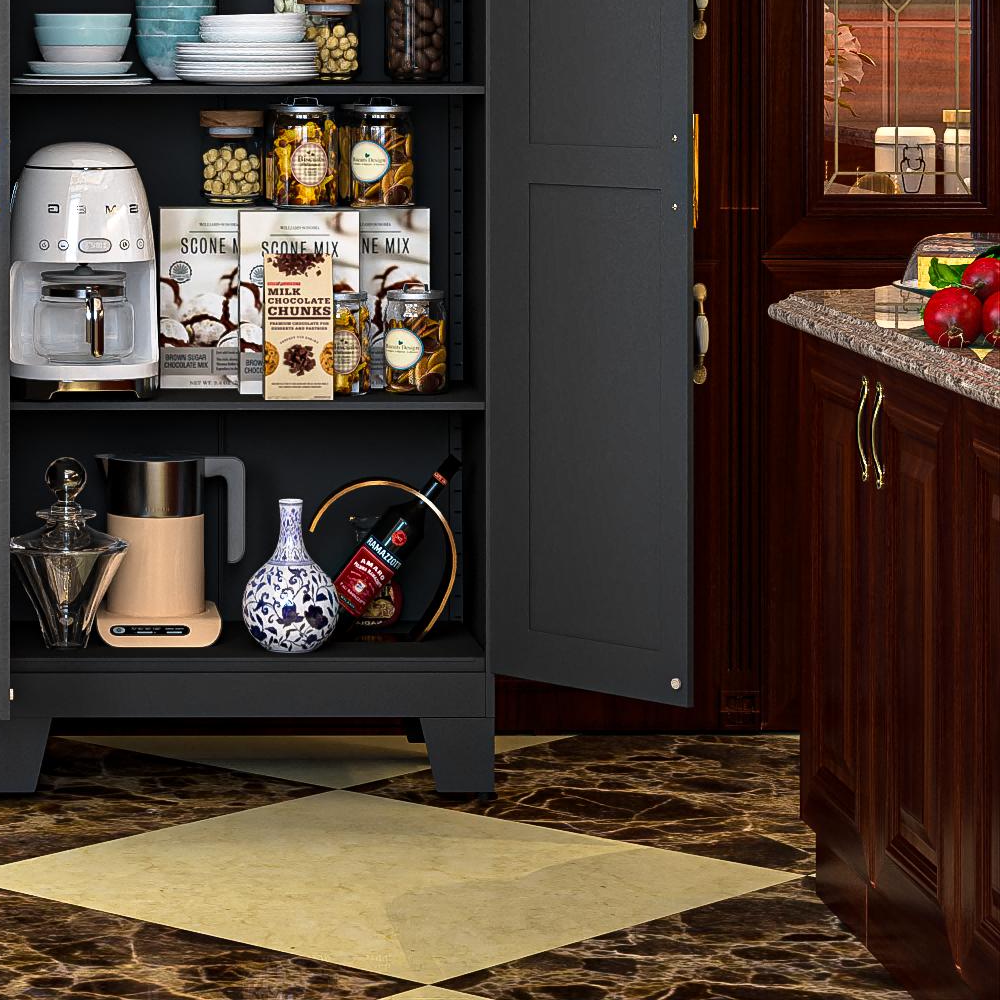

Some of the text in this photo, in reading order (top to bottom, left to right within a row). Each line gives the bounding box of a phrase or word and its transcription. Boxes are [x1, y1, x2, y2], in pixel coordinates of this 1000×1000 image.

[180, 237, 226, 254] SCONE
[261, 241, 339, 258] SCONE MIX
[385, 237, 410, 254] MIX
[267, 306, 332, 316] CHUNKS
[165, 353, 207, 361] BROWN SUGAR
[245, 359, 263, 367] BROW
[163, 361, 209, 369] CHOCOLATE MIX
[360, 558, 386, 581] AMARO
